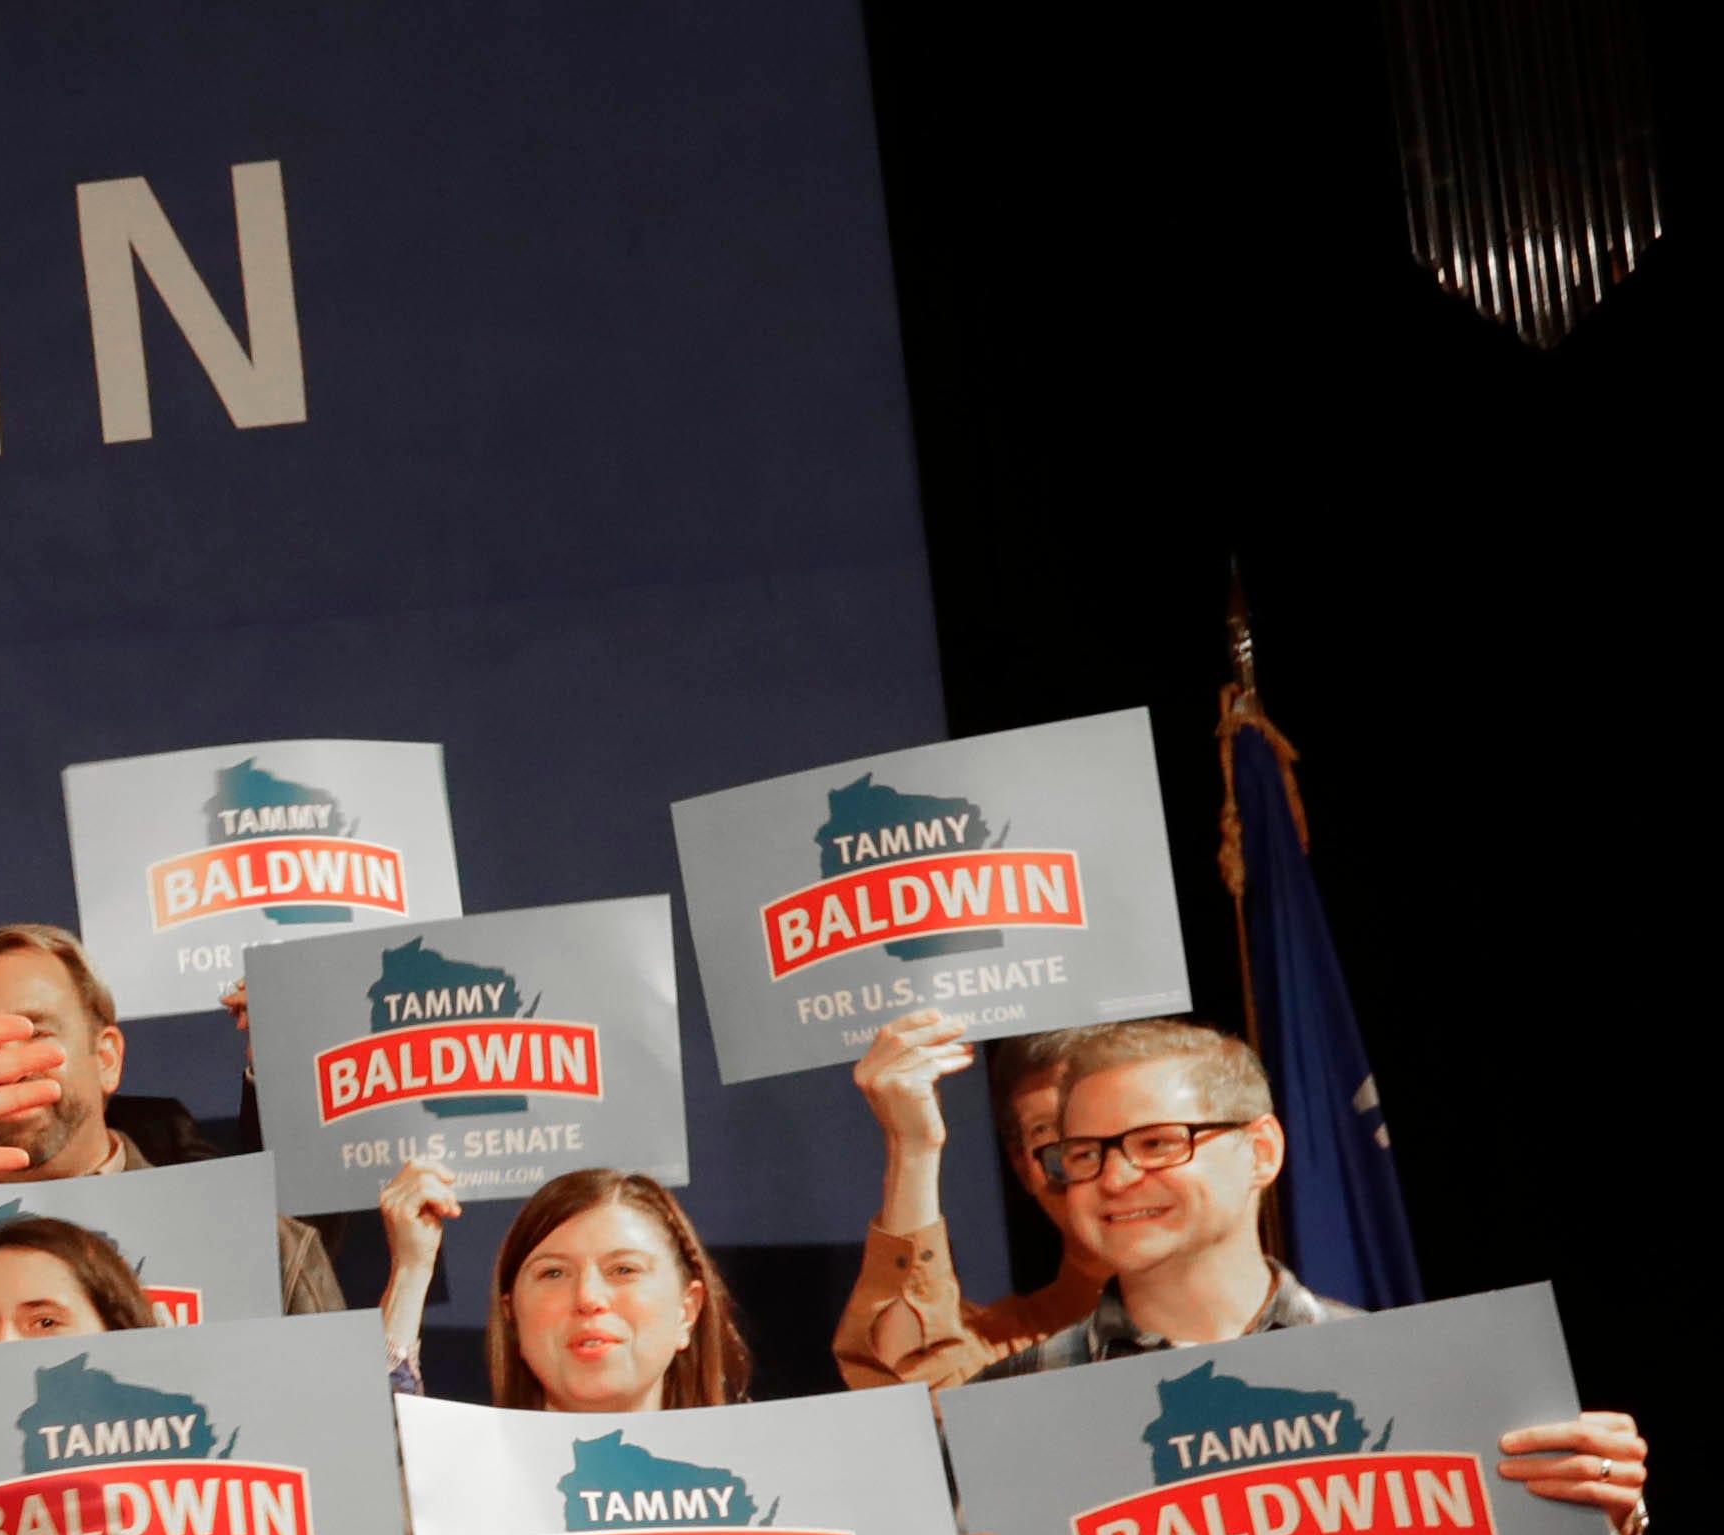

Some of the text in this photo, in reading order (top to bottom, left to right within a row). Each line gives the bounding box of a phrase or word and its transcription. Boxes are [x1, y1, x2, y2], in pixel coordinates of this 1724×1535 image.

[217, 804, 334, 836] TAMMY
[833, 815, 969, 865] TAMMY
[163, 850, 398, 918] BALDWIN
[778, 864, 1068, 963] BALDWIN
[178, 944, 233, 974] FOR
[383, 982, 506, 1023] TAMMY
[797, 956, 1068, 1024] FOR U.S. SENATE
[327, 1032, 588, 1109] BALDWIN
[341, 1123, 585, 1168] FOR U.S. SENATE
[38, 1414, 198, 1460] TAMMY
[1169, 1410, 1342, 1468] TAMMY
[580, 1485, 735, 1524] TAMMY
